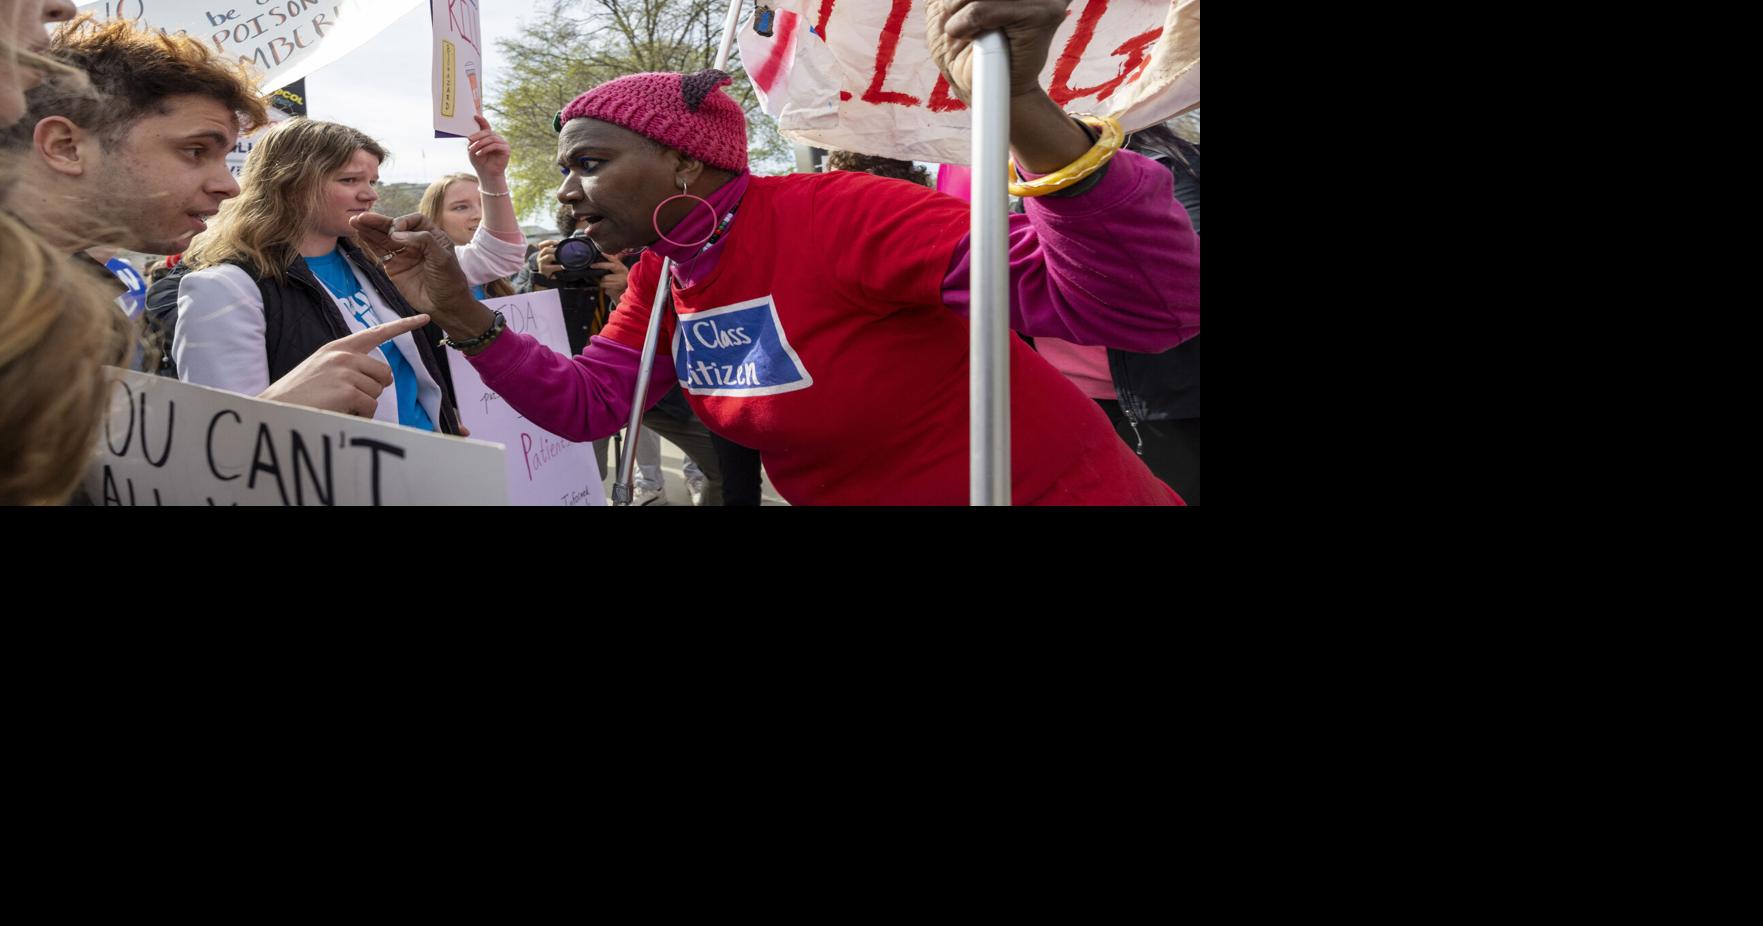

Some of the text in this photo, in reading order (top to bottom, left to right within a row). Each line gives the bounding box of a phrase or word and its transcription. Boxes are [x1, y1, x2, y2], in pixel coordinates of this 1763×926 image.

[205, 9, 241, 27] be
[692, 319, 752, 349] Class
[103, 378, 174, 468] OU
[206, 409, 406, 507] CAN'T
